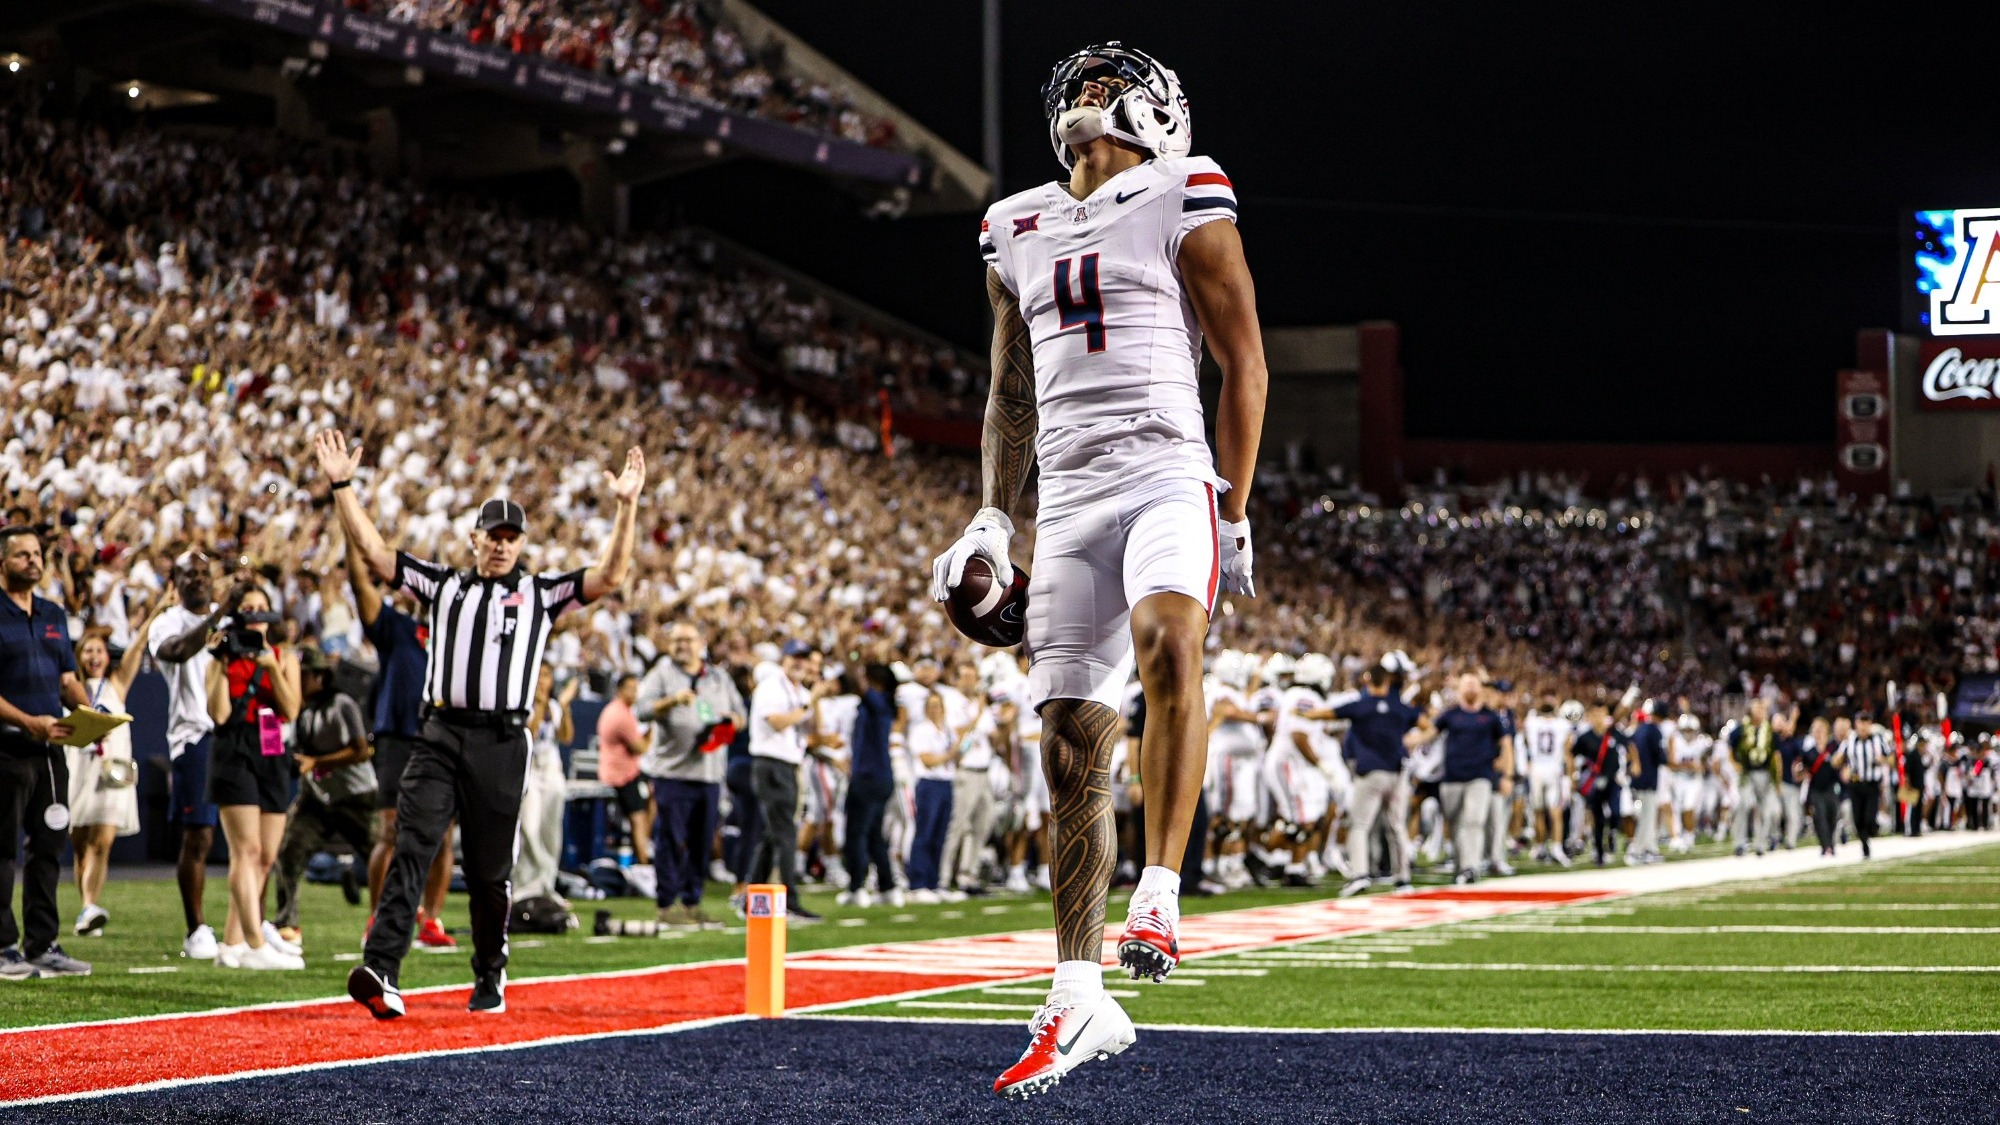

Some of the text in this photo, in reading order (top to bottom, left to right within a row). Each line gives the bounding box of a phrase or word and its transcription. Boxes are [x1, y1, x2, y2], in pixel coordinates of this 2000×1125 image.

[1074, 207, 1089, 223] A
[1053, 252, 1106, 354] 4
[1923, 347, 2000, 401] Coca
[751, 895, 770, 915] A
